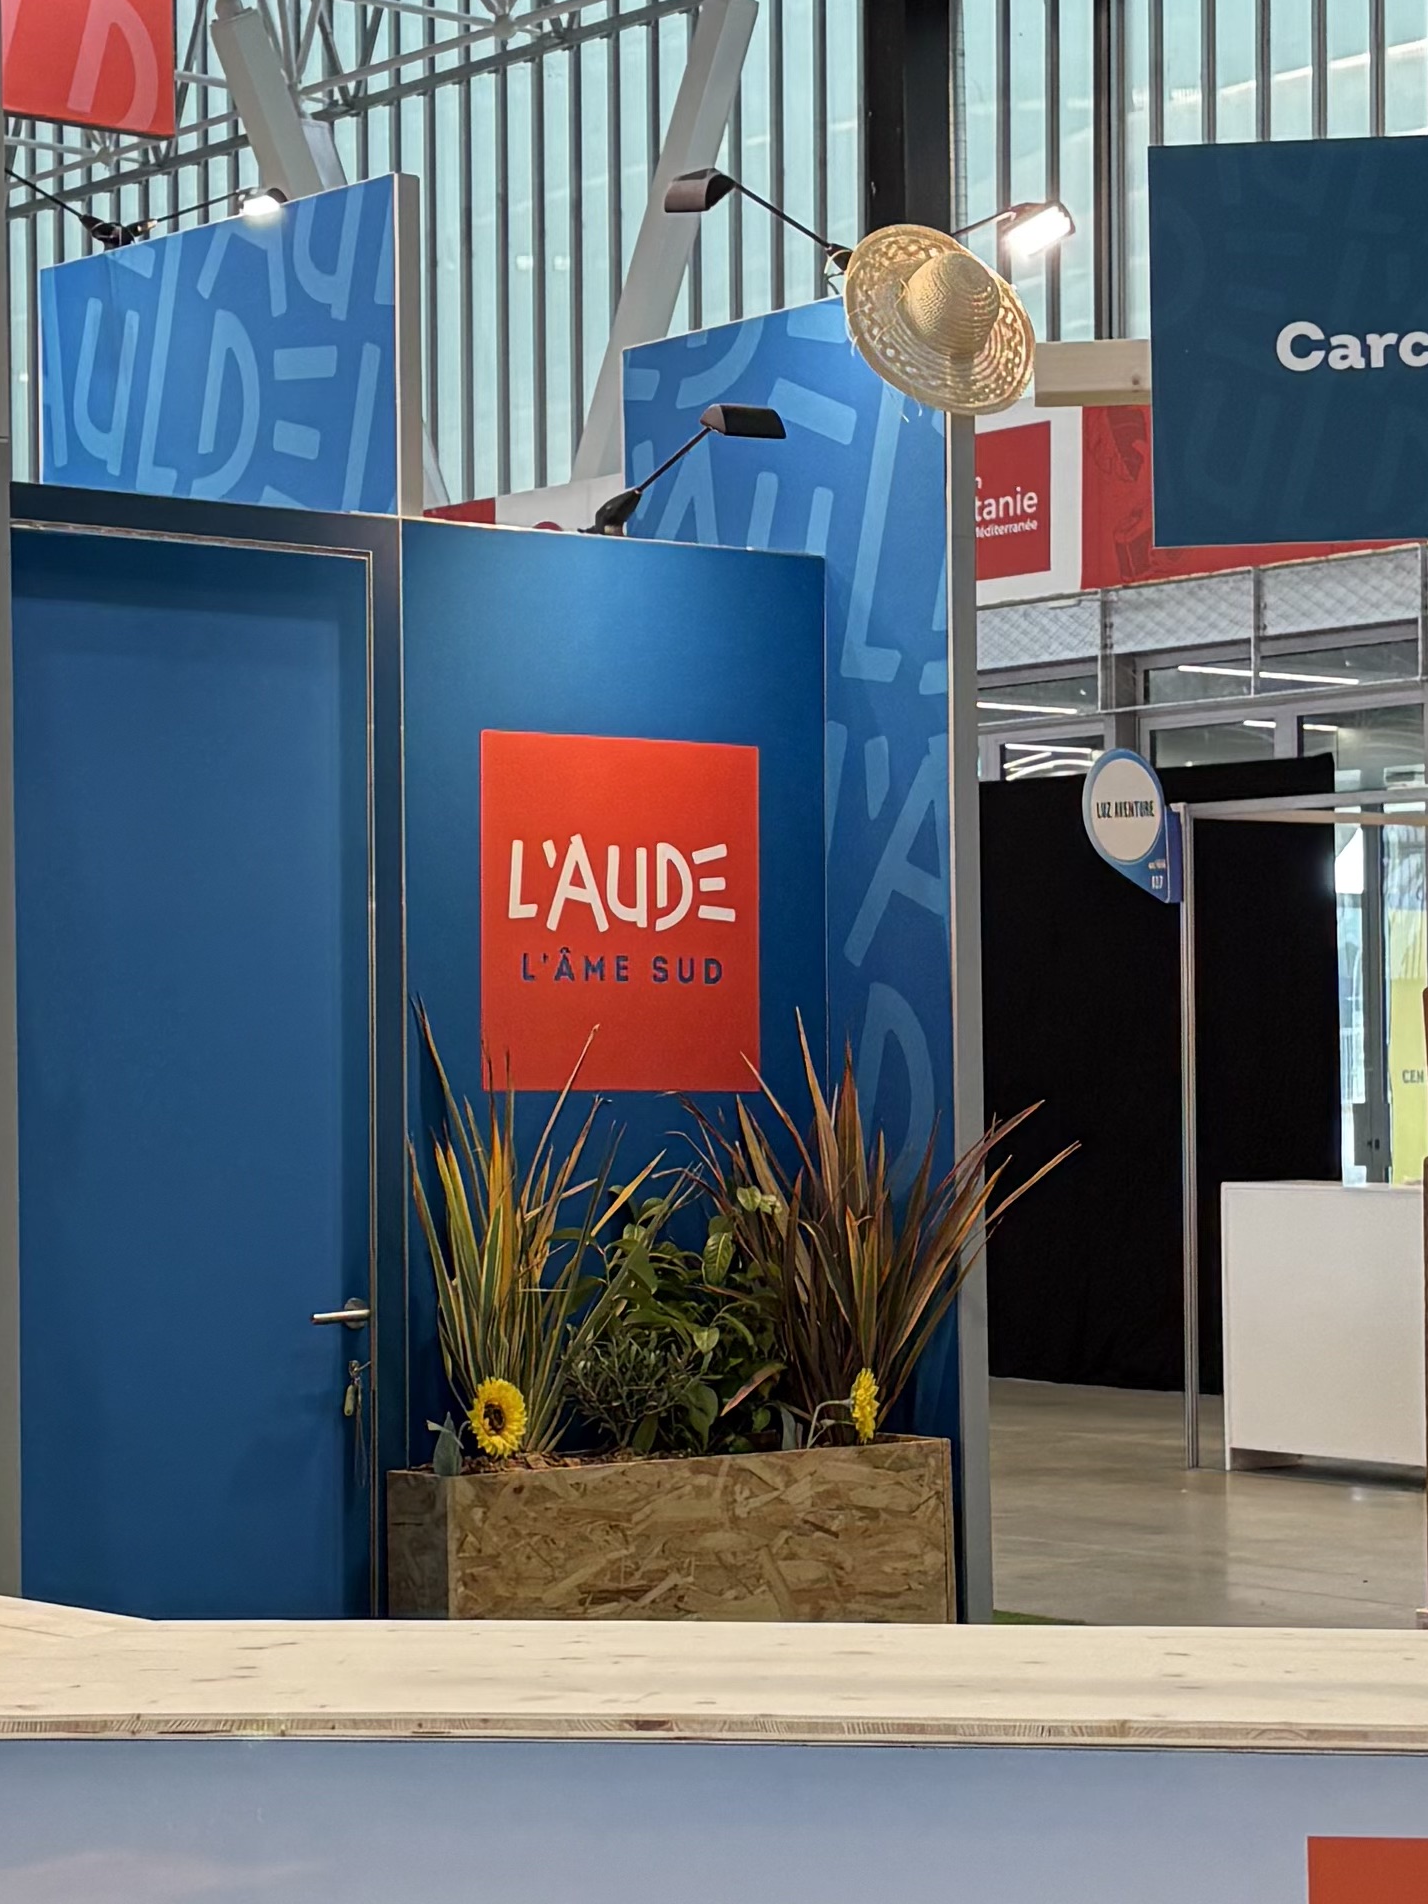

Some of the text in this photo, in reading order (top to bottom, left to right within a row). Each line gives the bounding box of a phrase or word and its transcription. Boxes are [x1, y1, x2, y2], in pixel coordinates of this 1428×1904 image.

[1096, 801, 1112, 819] LUZ
[508, 833, 737, 933] L'AUDE
[521, 947, 723, 986] L'ÂME SUD
